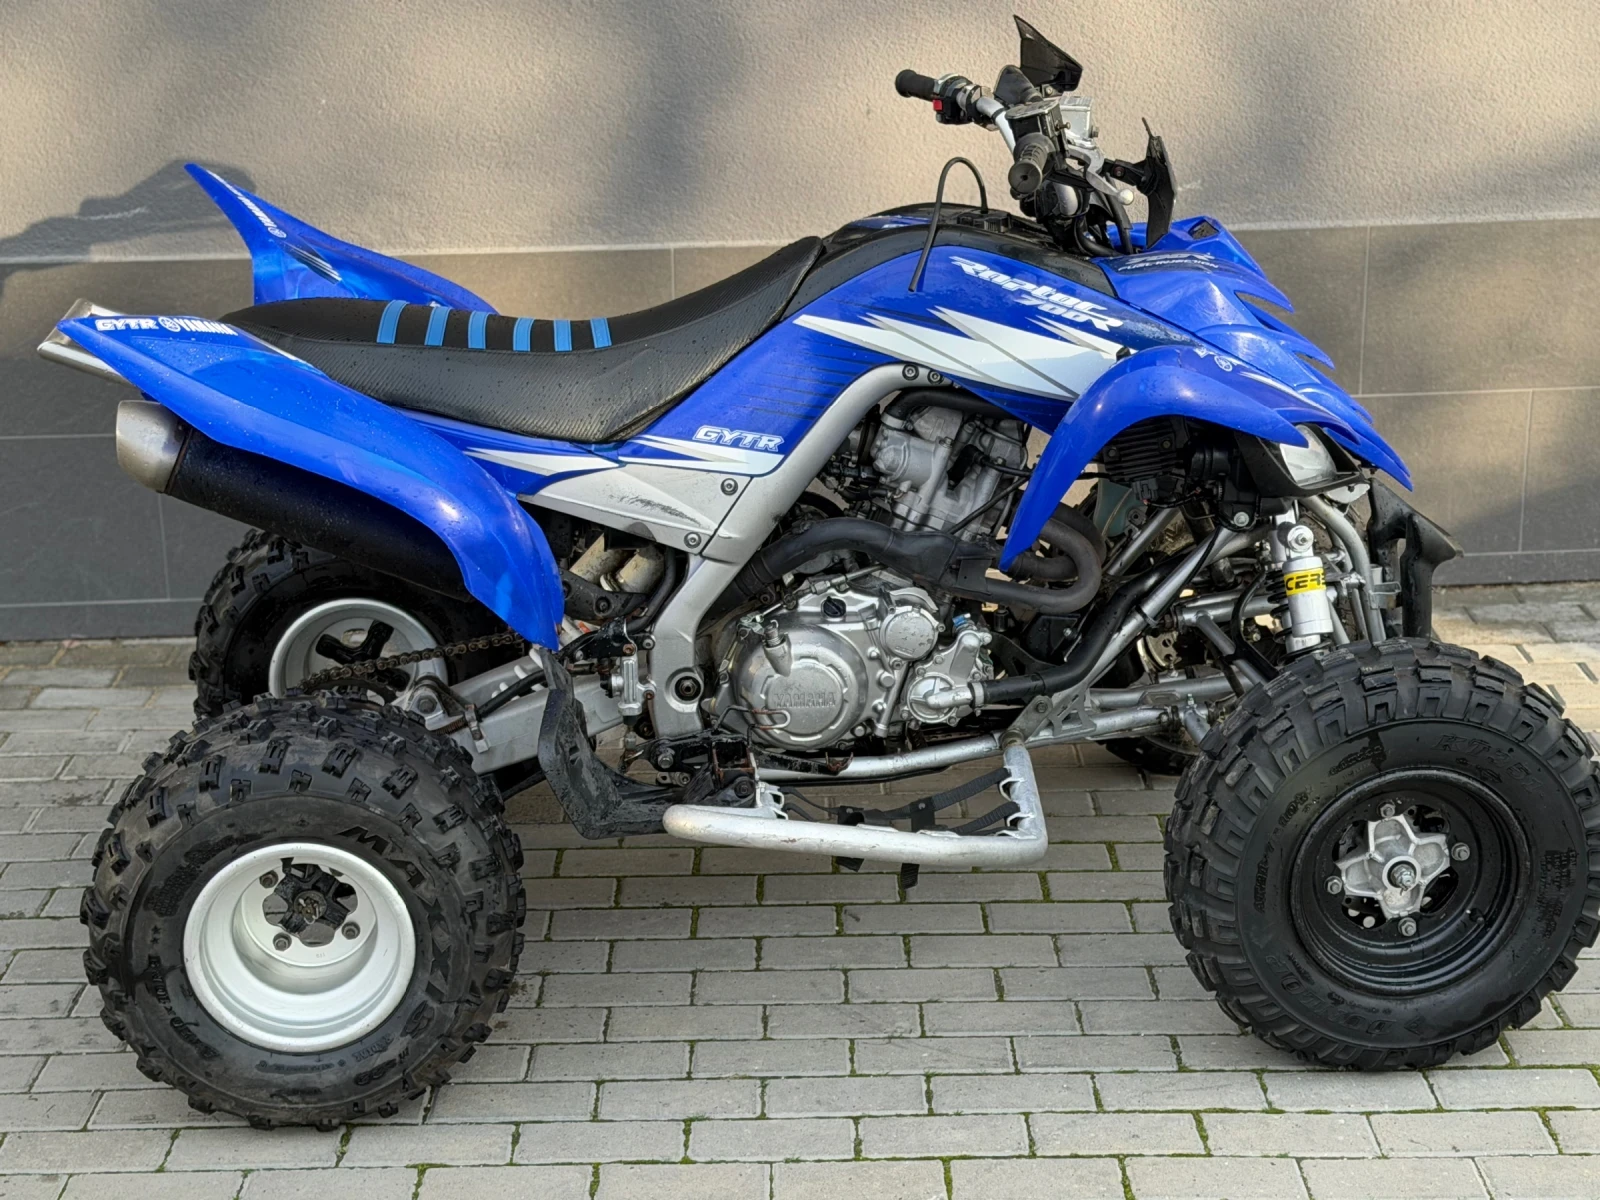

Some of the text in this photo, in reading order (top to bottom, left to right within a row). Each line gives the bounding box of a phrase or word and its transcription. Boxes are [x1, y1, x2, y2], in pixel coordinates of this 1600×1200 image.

[94, 317, 239, 337] GYTR YAMAHA
[1013, 294, 1124, 333] 700R
[692, 424, 785, 452] GYTR
[334, 825, 452, 1039] MAXXIS
